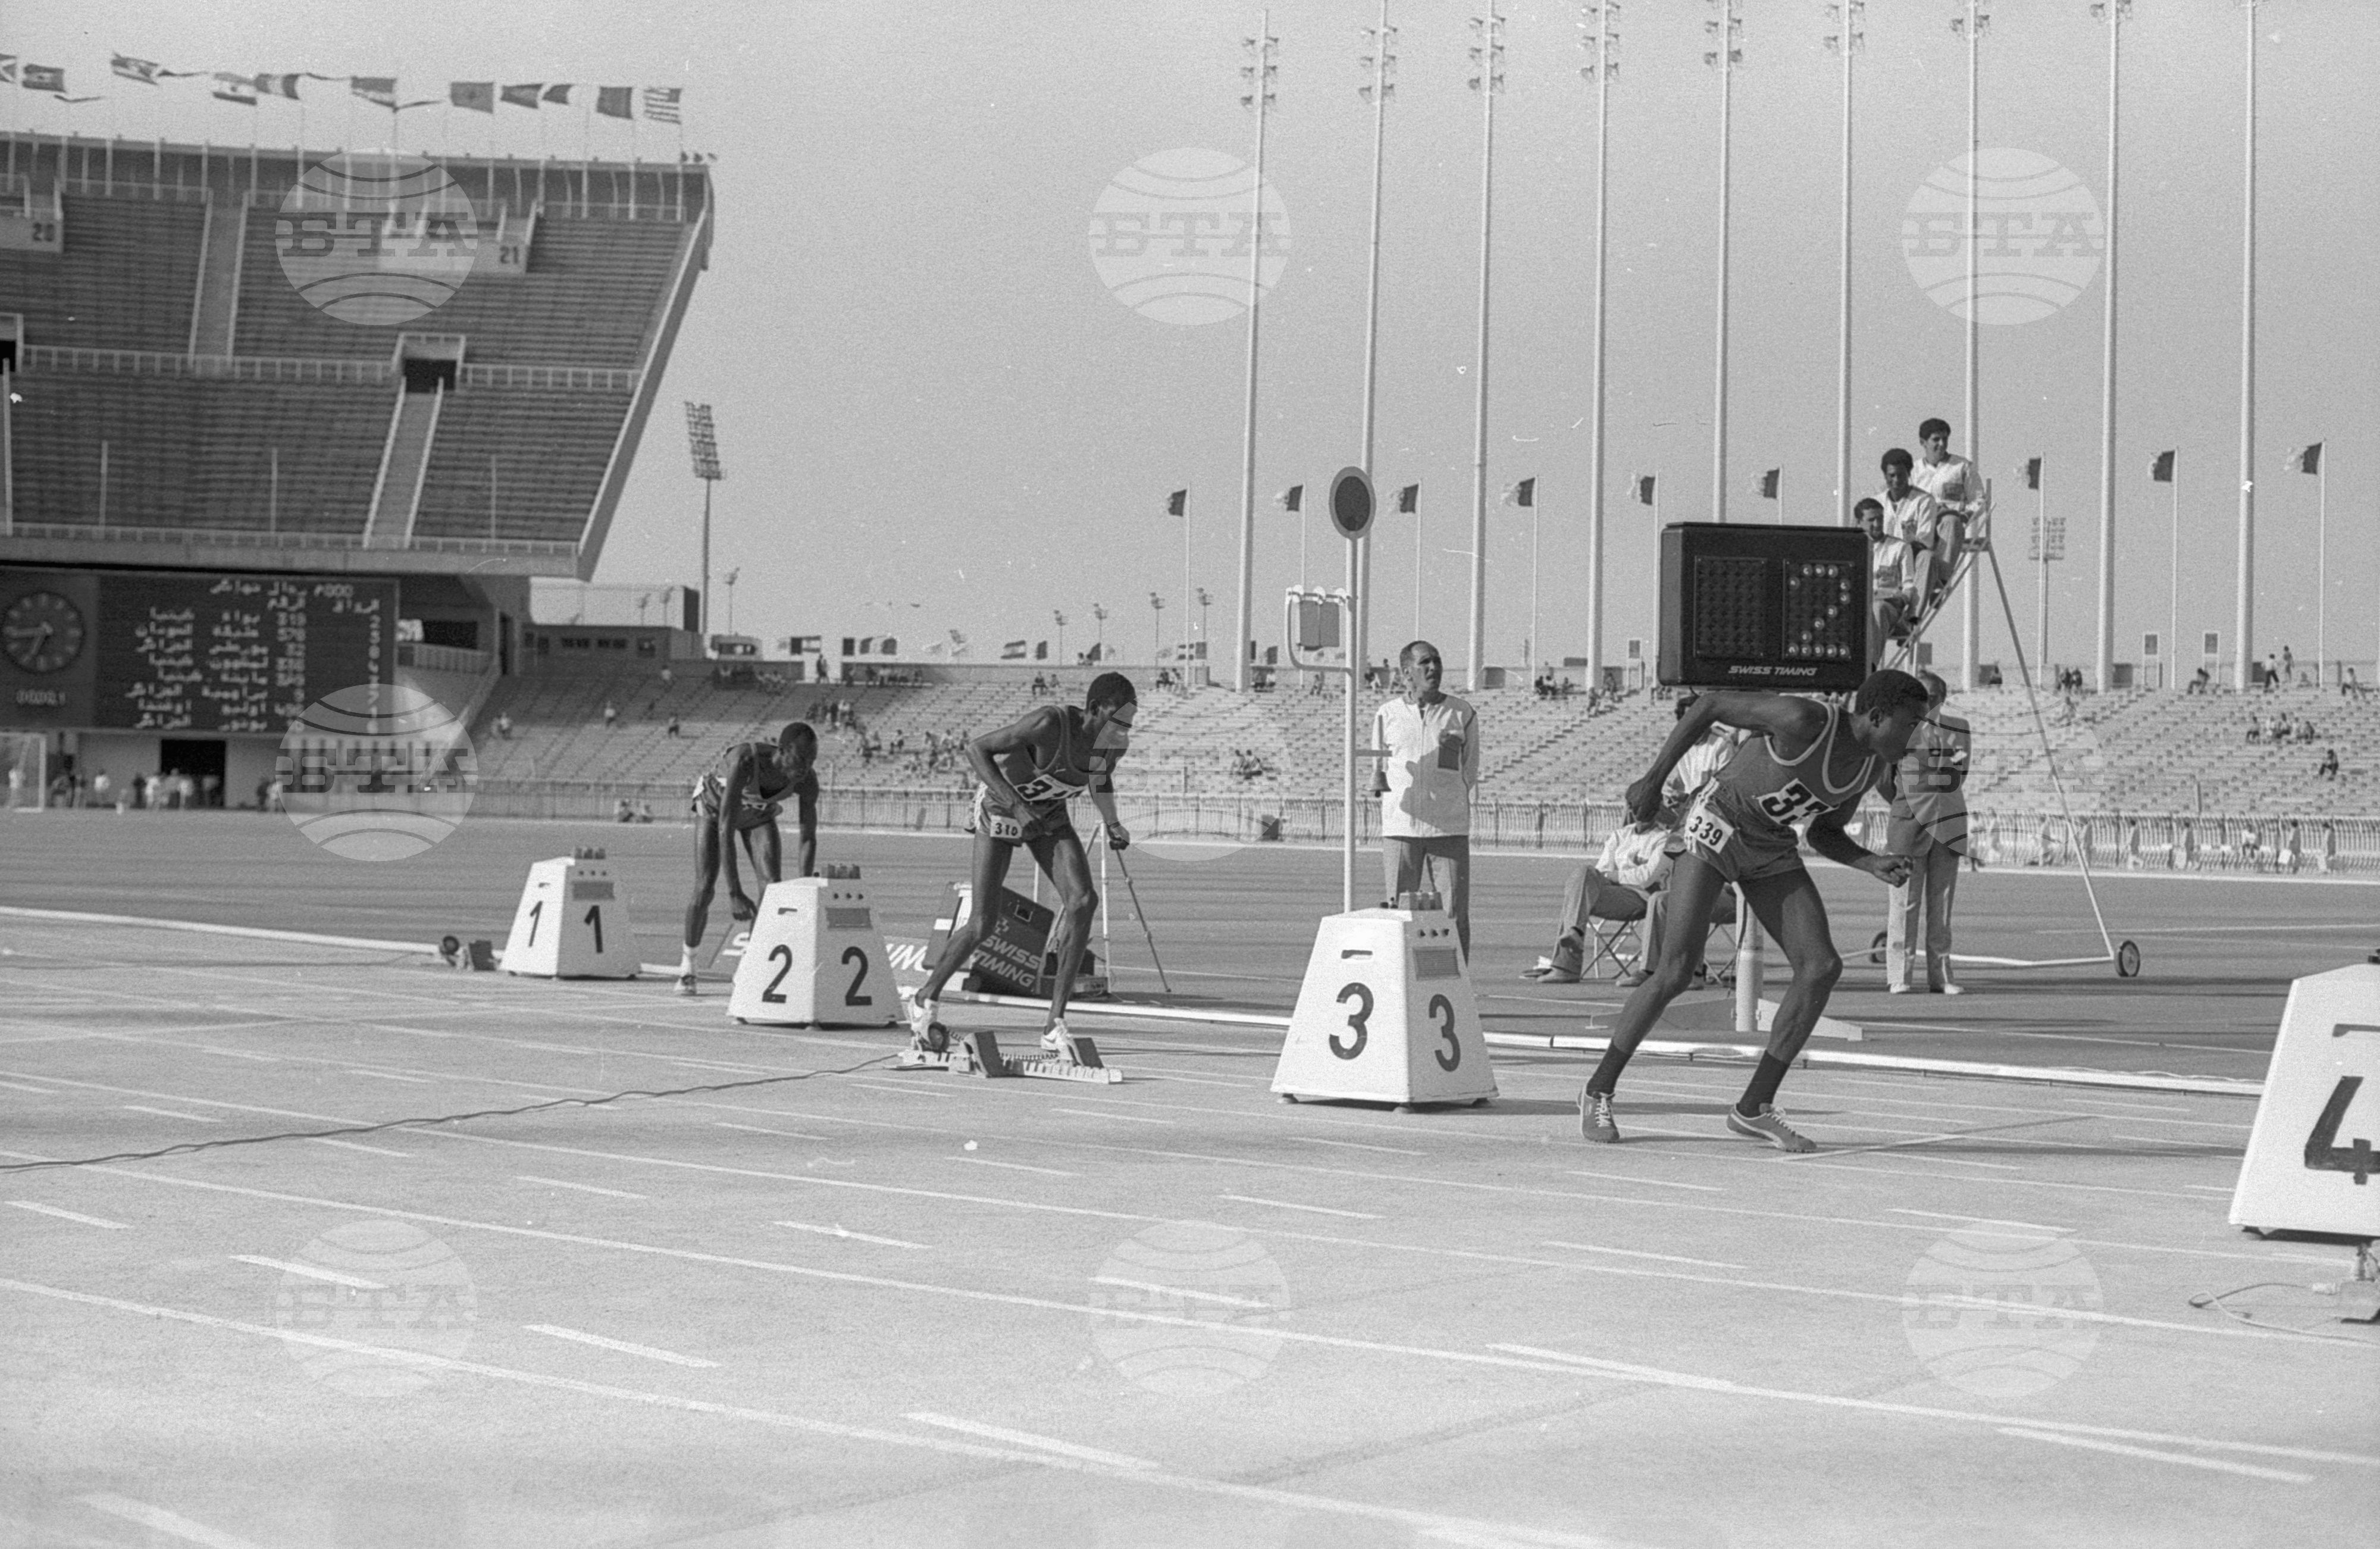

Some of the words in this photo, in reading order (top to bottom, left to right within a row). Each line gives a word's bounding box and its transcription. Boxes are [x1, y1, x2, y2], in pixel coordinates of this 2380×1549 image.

[499, 246, 519, 265] 21
[1787, 563, 1851, 657] 2
[1728, 665, 1773, 675] SWISS
[1774, 666, 1818, 676] TIMING
[995, 822, 1019, 836] 310
[1689, 815, 1723, 846] 339
[528, 900, 543, 948] 1
[584, 905, 604, 953] 1
[762, 944, 793, 1004] 2
[841, 946, 873, 1006] 2
[972, 949, 1036, 987] TIMING
[981, 935, 1042, 969] SWISS
[1329, 982, 1374, 1060] 3
[1429, 993, 1461, 1072] 3
[2304, 1075, 2380, 1185] 4
